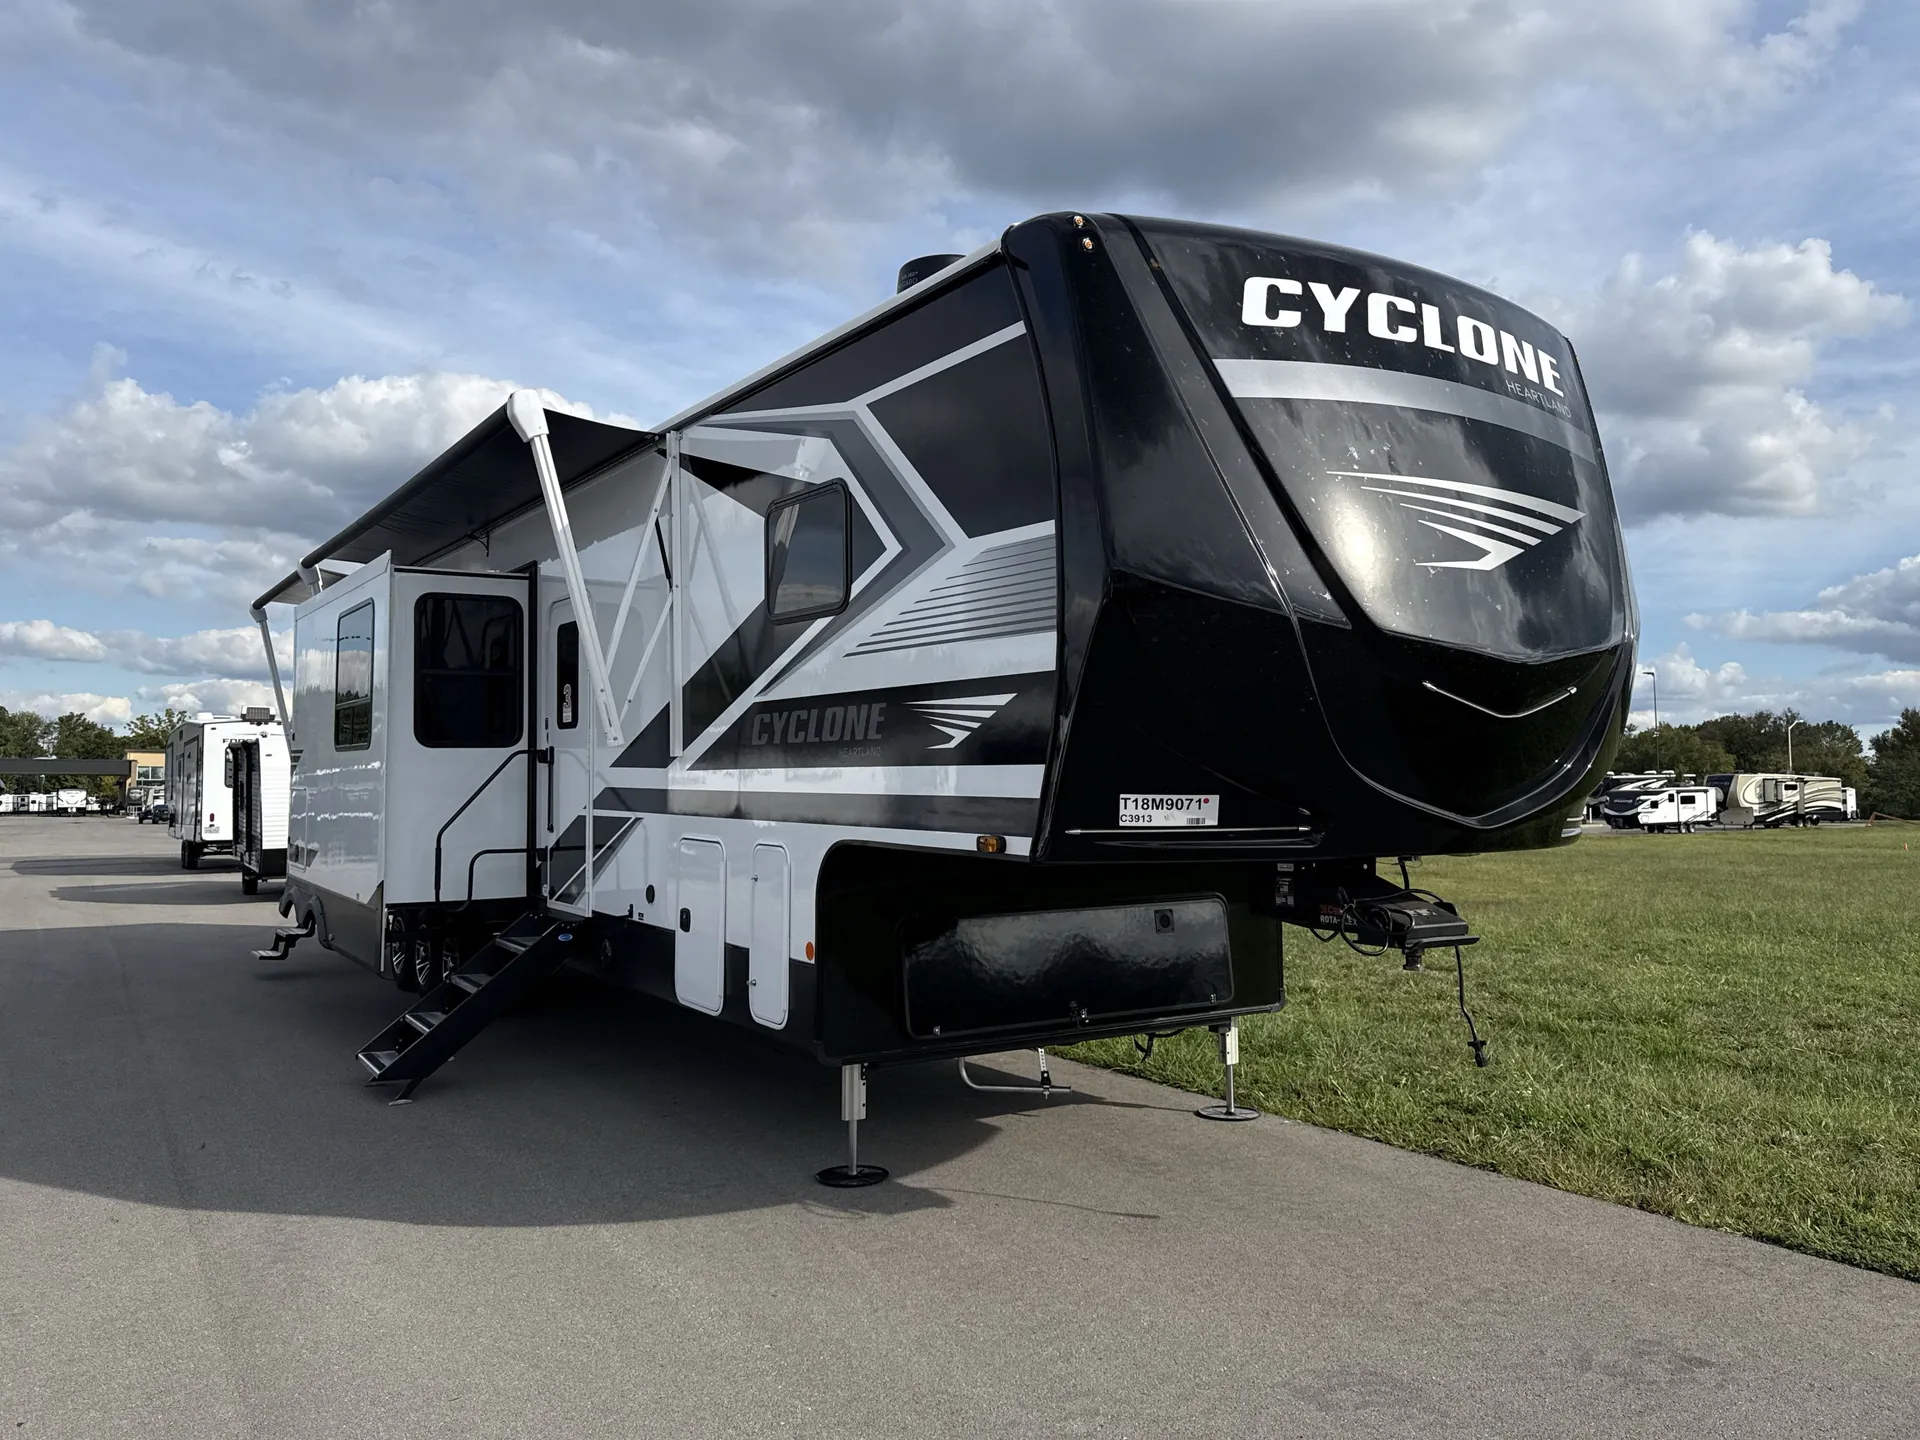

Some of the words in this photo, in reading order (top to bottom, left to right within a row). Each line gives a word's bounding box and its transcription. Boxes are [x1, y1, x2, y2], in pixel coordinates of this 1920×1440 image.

[1241, 276, 1564, 397] CYCLONE
[1505, 379, 1572, 418] HEARTLAND
[751, 703, 887, 746] CYCLONE
[838, 746, 882, 757] HEARTLAND
[1120, 797, 1202, 811] T18M9071
[1120, 814, 1153, 823] C3913
